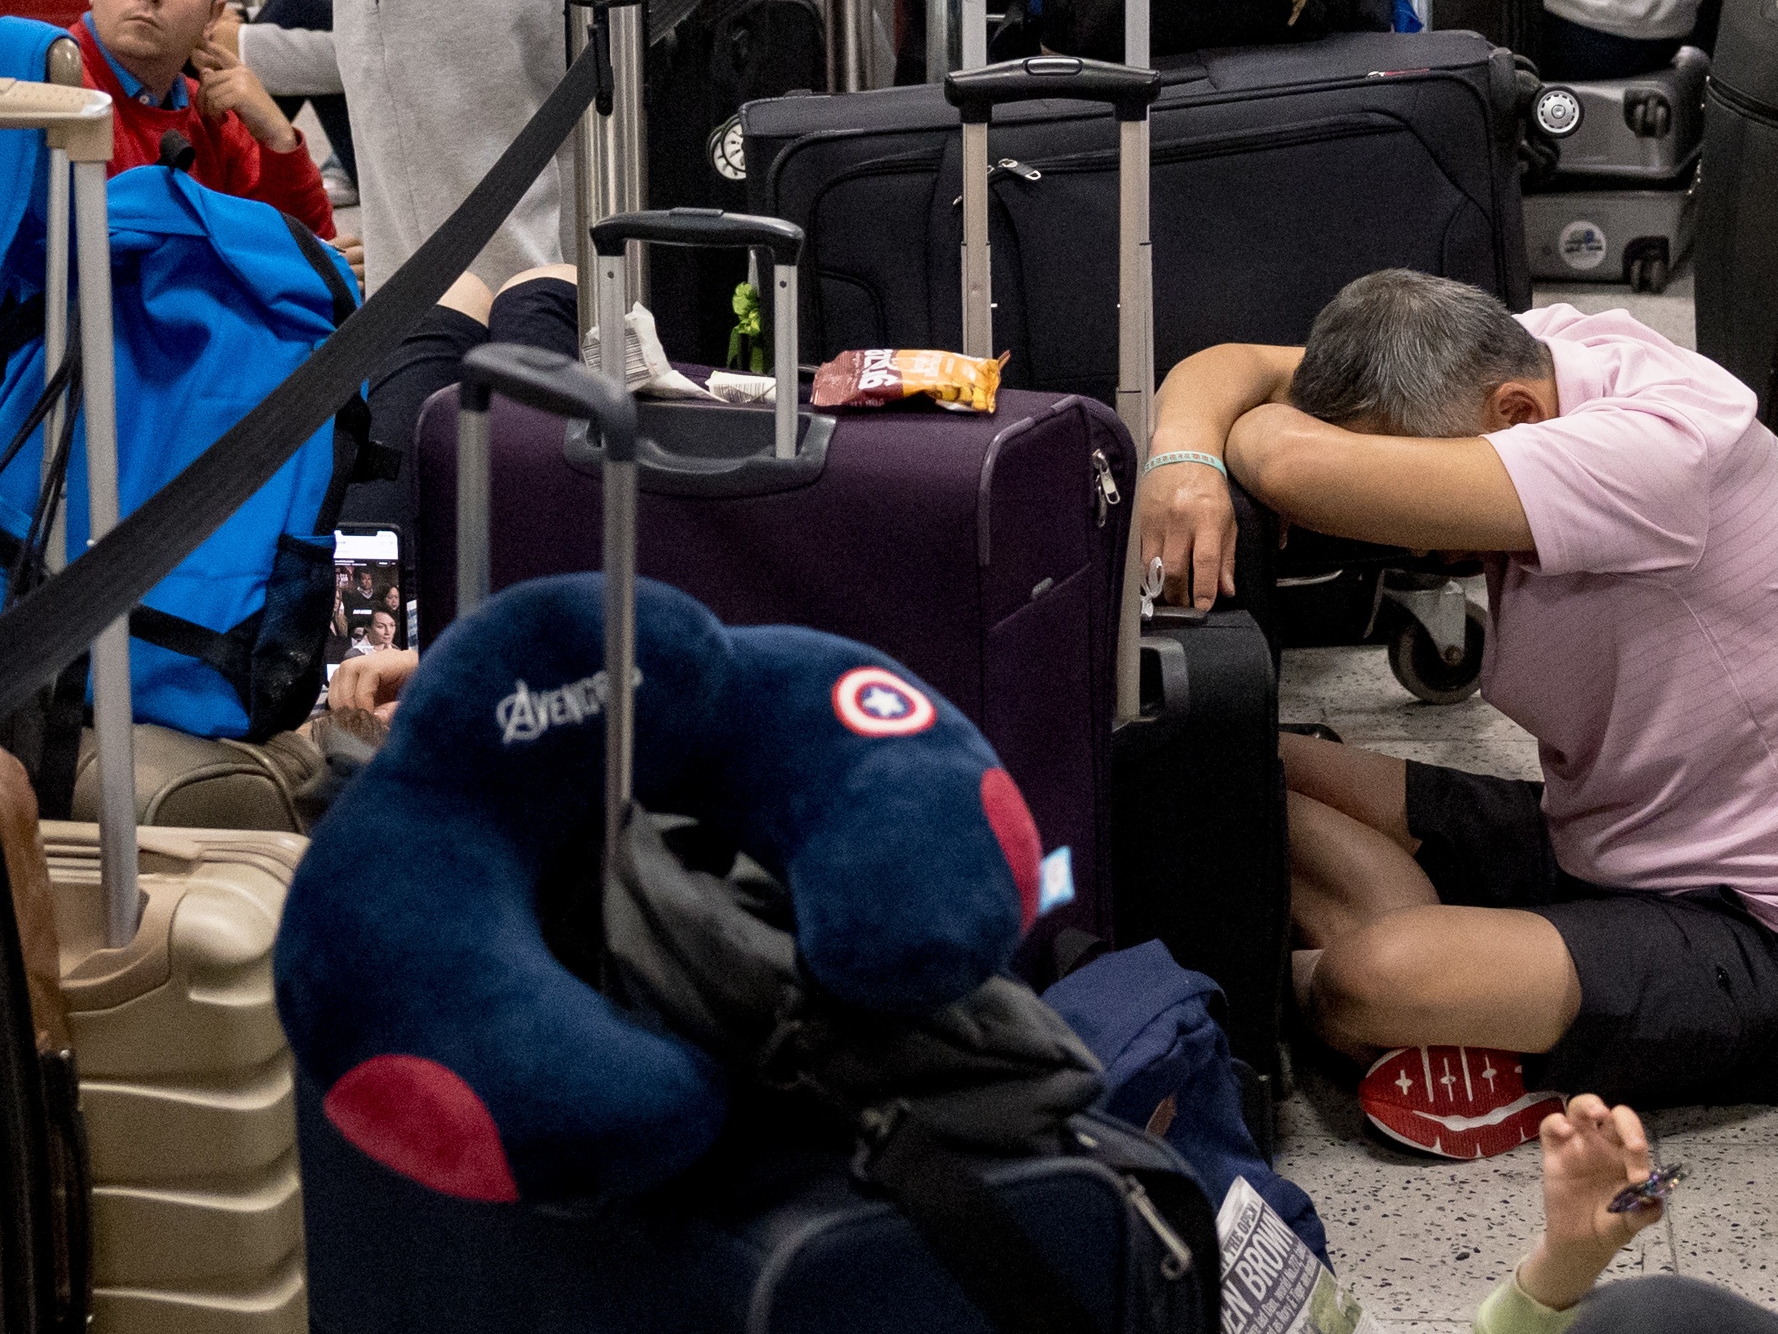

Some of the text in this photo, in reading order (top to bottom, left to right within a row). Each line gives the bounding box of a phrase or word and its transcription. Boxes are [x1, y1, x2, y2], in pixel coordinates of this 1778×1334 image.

[1221, 1229, 1245, 1257] THE
[1236, 1203, 1259, 1235] OPEN
[1235, 1207, 1294, 1302] BROWN
